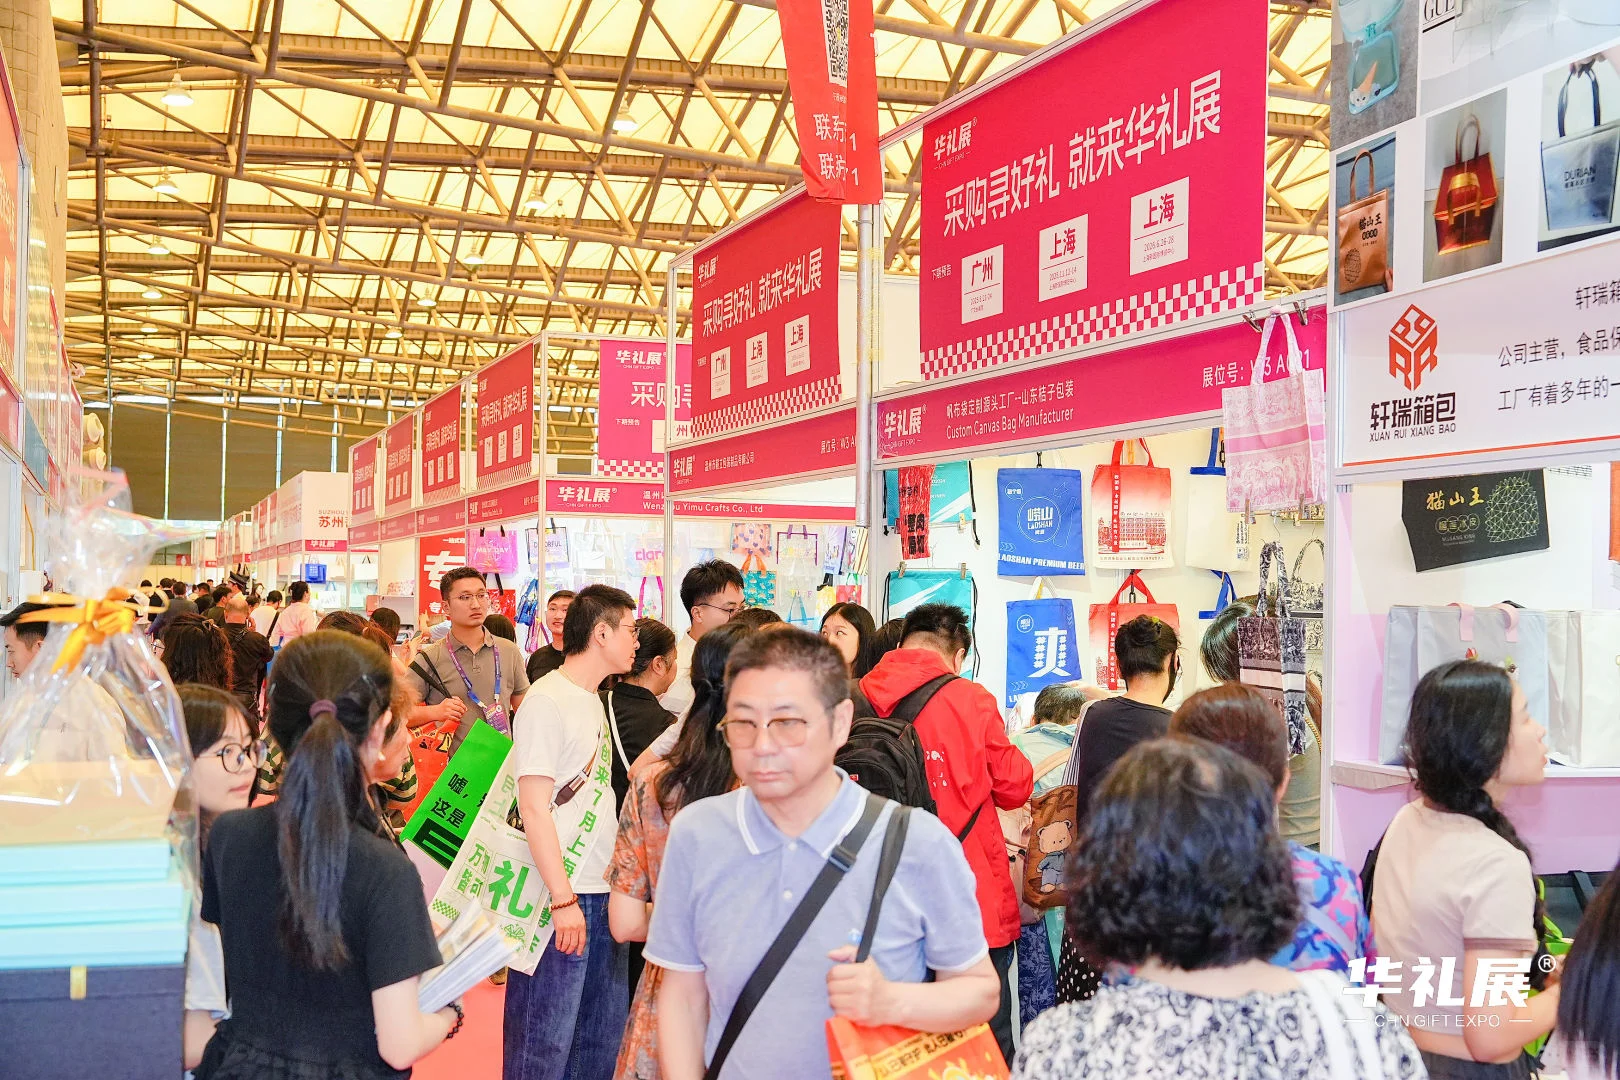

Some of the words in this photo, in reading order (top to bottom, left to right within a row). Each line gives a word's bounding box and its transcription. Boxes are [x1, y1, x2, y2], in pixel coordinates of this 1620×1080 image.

[934, 121, 972, 161] 华礼展
[943, 144, 1060, 237] 采购寻好礼
[1068, 70, 1221, 190] 就来华礼展
[1144, 193, 1174, 229] 上海
[1050, 228, 1076, 260] 上海
[971, 255, 994, 286] 广州
[703, 281, 755, 337] 采购寻好礼
[758, 247, 822, 314] 就来华礼展
[751, 340, 763, 361] 上海
[791, 324, 804, 346] 上海
[616, 350, 662, 366] 华礼展
[1498, 376, 1620, 411] 工厂有着多年的一
[884, 406, 922, 438] 华礼展
[947, 424, 972, 440] Custom
[974, 420, 1000, 435] Canvas
[1002, 416, 1016, 433] Bag
[1018, 407, 1074, 429] Manufacturer
[1370, 392, 1456, 431] 轩瑞箱包
[1369, 431, 1391, 442] XUAN
[1394, 429, 1407, 439] RUI
[1411, 426, 1435, 438] XIANG
[1439, 422, 1456, 434] BAO
[674, 456, 693, 478] 华礼展
[558, 487, 611, 502] 华礼展
[643, 501, 680, 511] Wenzou
[683, 503, 703, 512] Yimu
[705, 503, 730, 513] Crafts
[732, 504, 748, 514] Co.,
[750, 504, 762, 513] Ltd
[1426, 487, 1485, 511] 猫山王
[1028, 507, 1053, 521] 崂山
[1028, 520, 1053, 529] LAOSHAN
[997, 553, 1032, 564] LAOSHAN
[1033, 557, 1067, 569] PREMIUM
[1068, 561, 1085, 570] BEER
[1027, 627, 1071, 677] 爽
[430, 797, 466, 829] 这是
[488, 860, 534, 918] 礼
